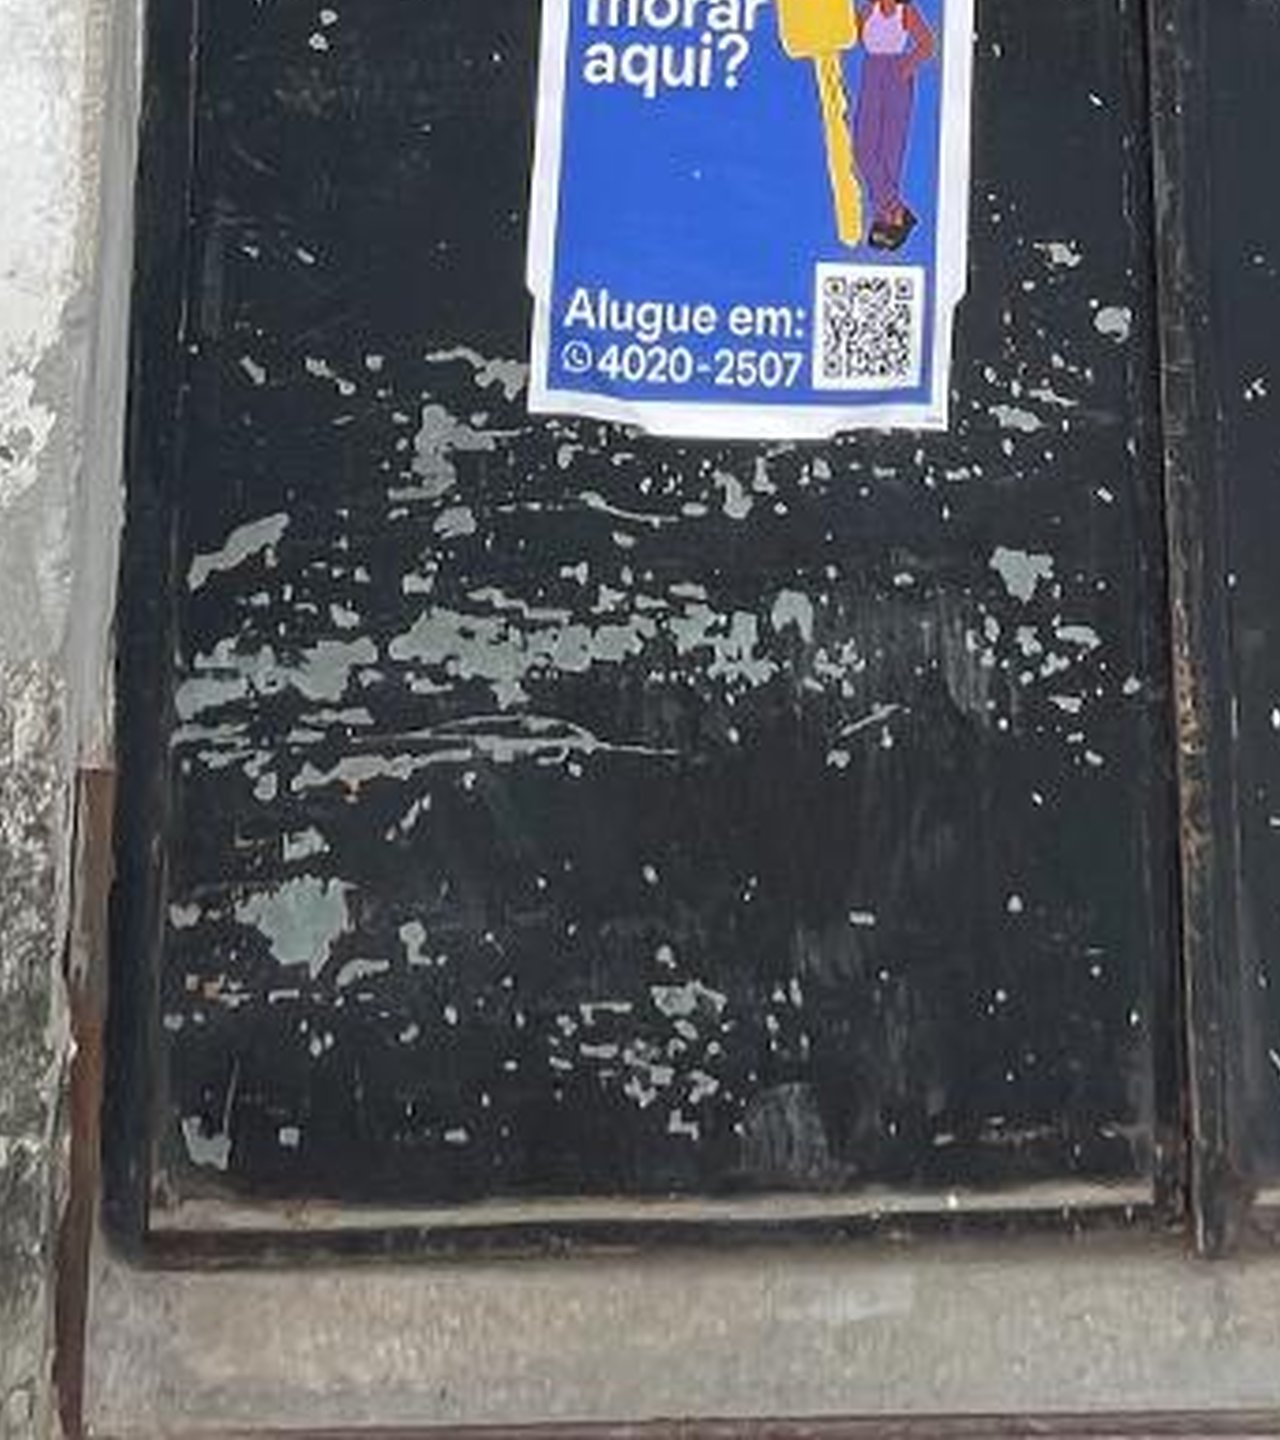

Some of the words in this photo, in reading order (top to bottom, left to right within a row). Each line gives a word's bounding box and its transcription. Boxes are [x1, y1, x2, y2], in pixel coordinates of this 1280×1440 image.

[583, 31, 750, 99] aqui?
[563, 287, 718, 343] Alugue
[728, 303, 806, 339] em:
[597, 344, 804, 388] 4020-2507
